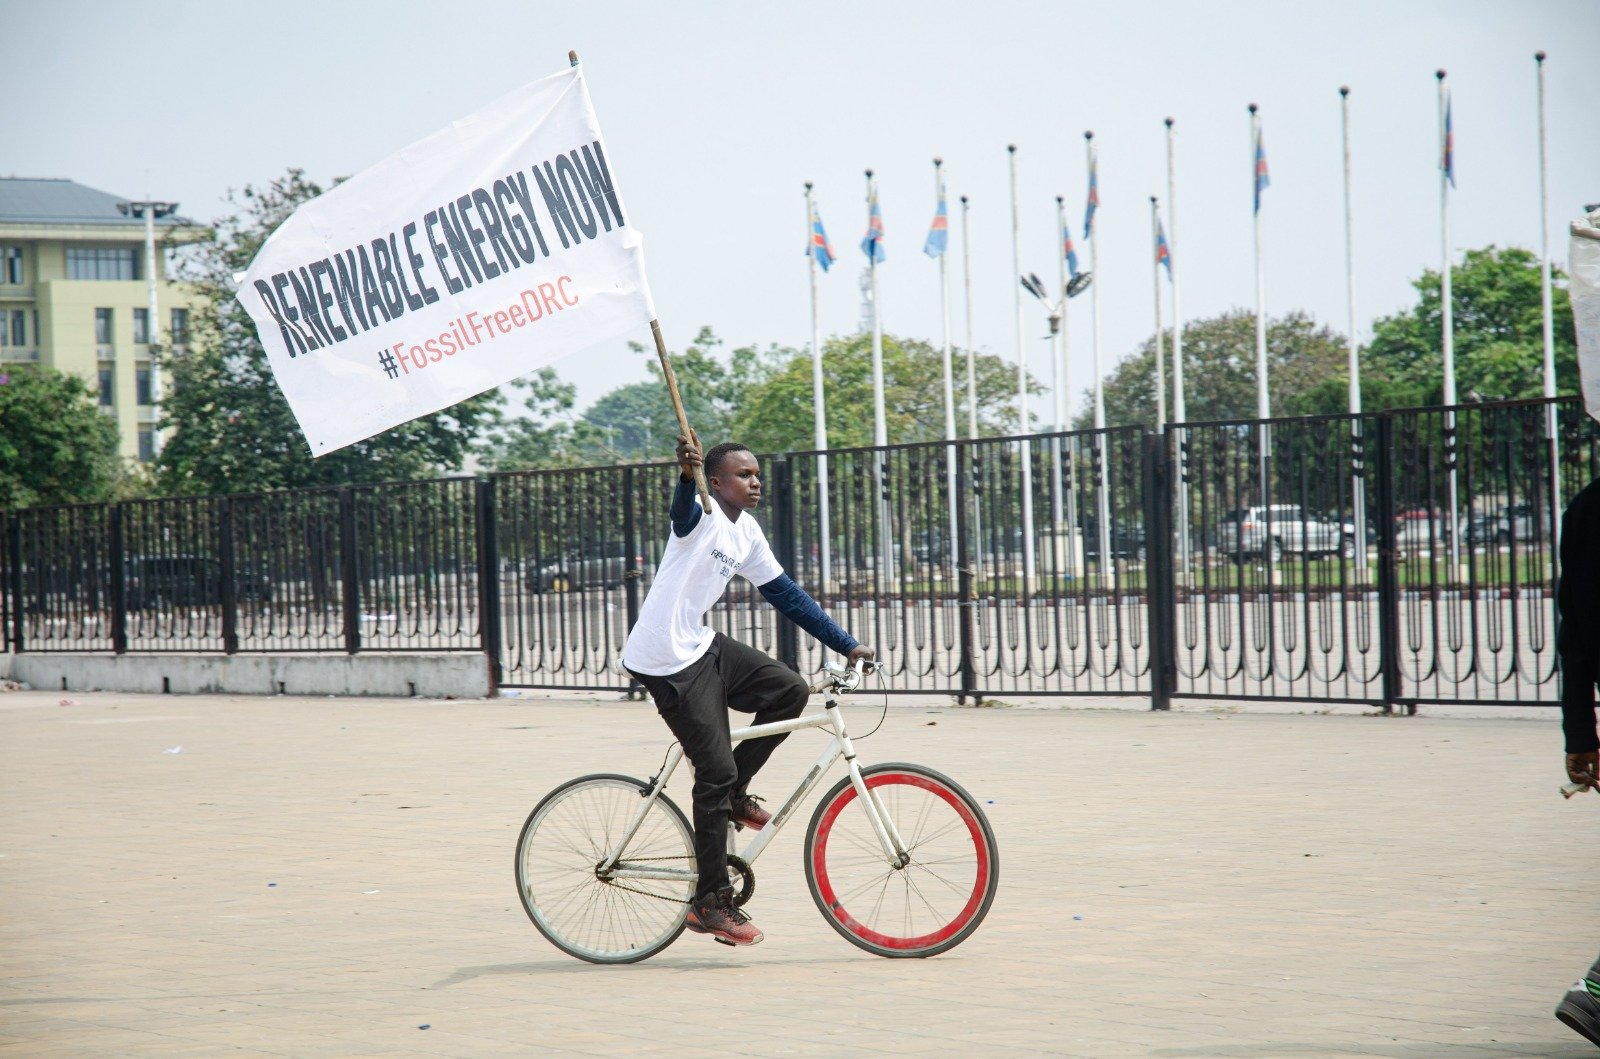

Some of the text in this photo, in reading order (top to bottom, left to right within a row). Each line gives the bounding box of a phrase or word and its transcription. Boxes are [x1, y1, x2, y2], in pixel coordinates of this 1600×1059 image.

[254, 140, 625, 358] RENEWABLE ENERGY NOW
[378, 275, 579, 380] #FossilFreeDRC
